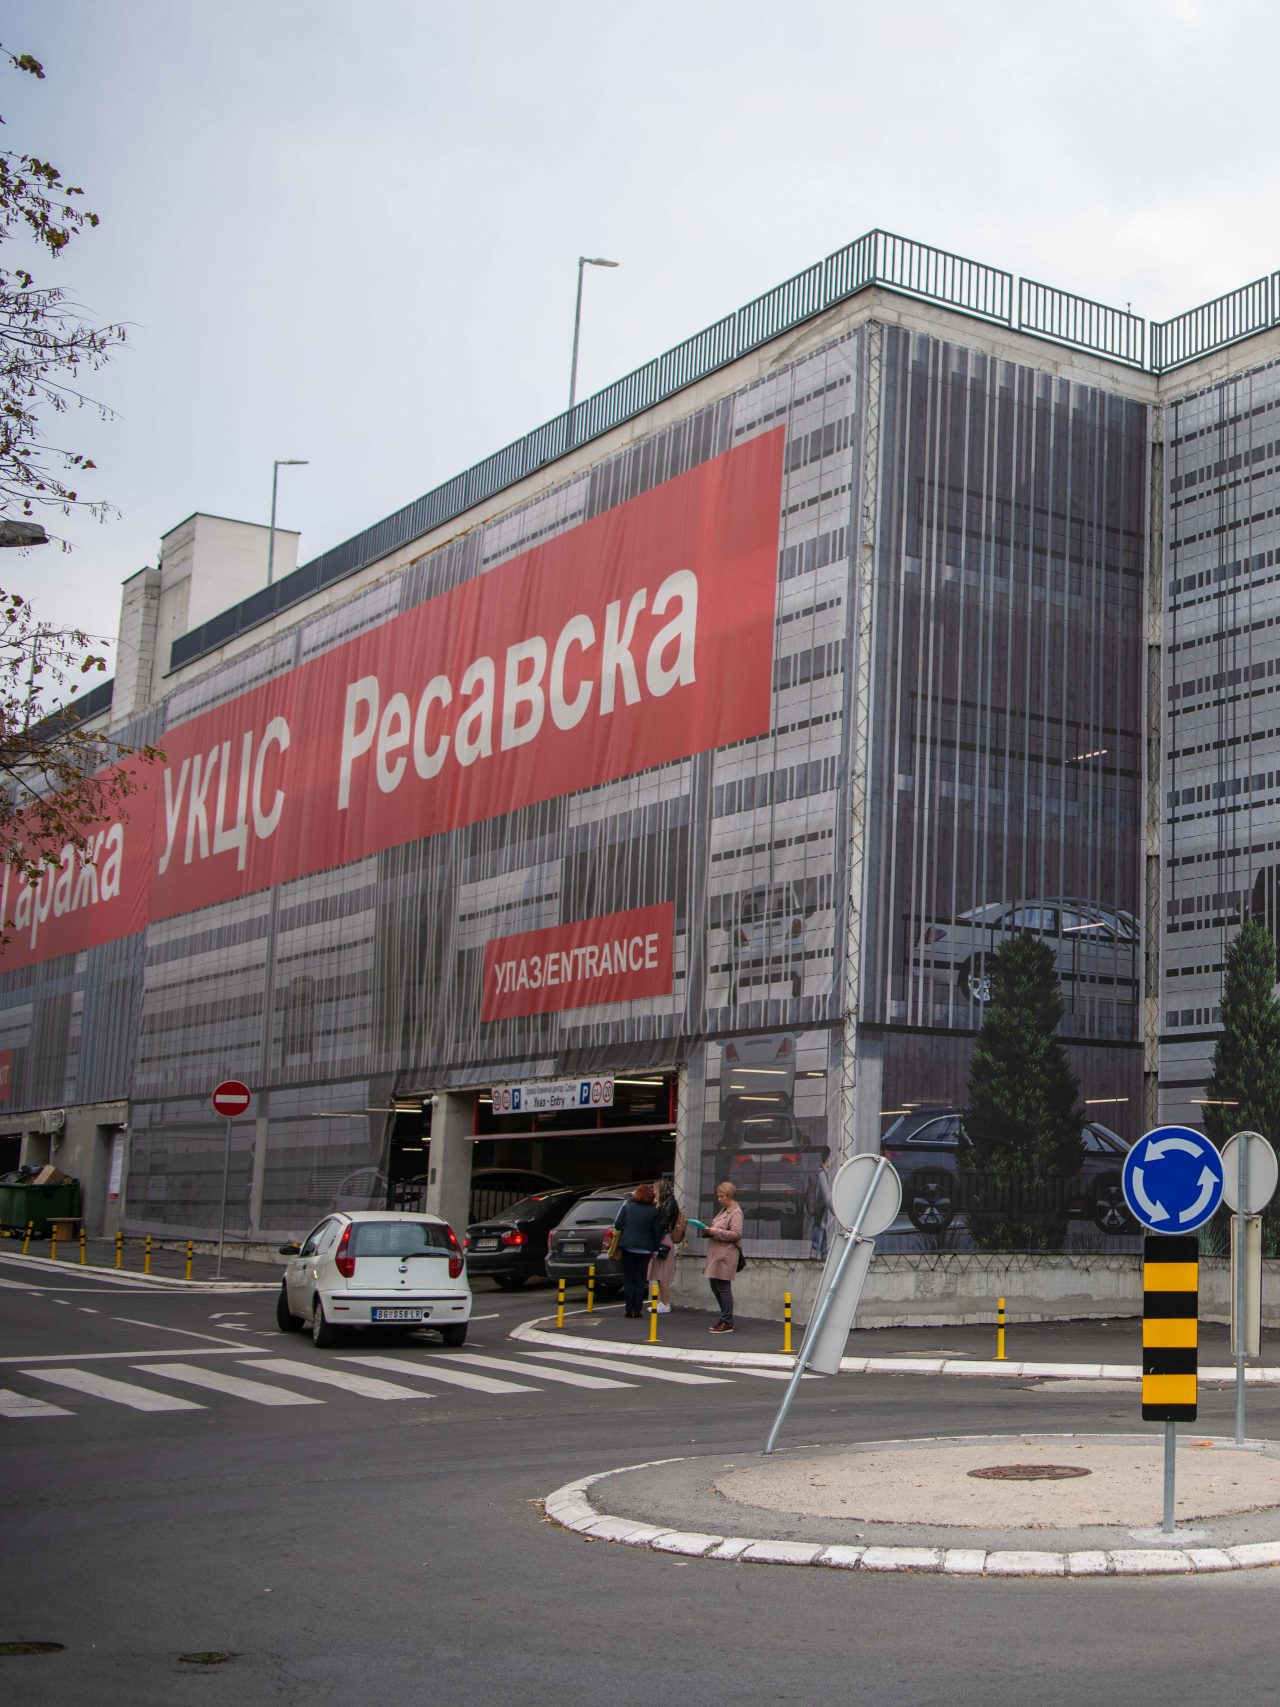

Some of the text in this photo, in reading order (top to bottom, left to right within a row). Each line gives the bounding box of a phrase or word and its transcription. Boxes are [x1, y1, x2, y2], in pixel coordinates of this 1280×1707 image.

[158, 716, 290, 875] УКЦС
[338, 569, 698, 810] Ресавска
[494, 933, 659, 994] УЛАЗ/ENTRANCE
